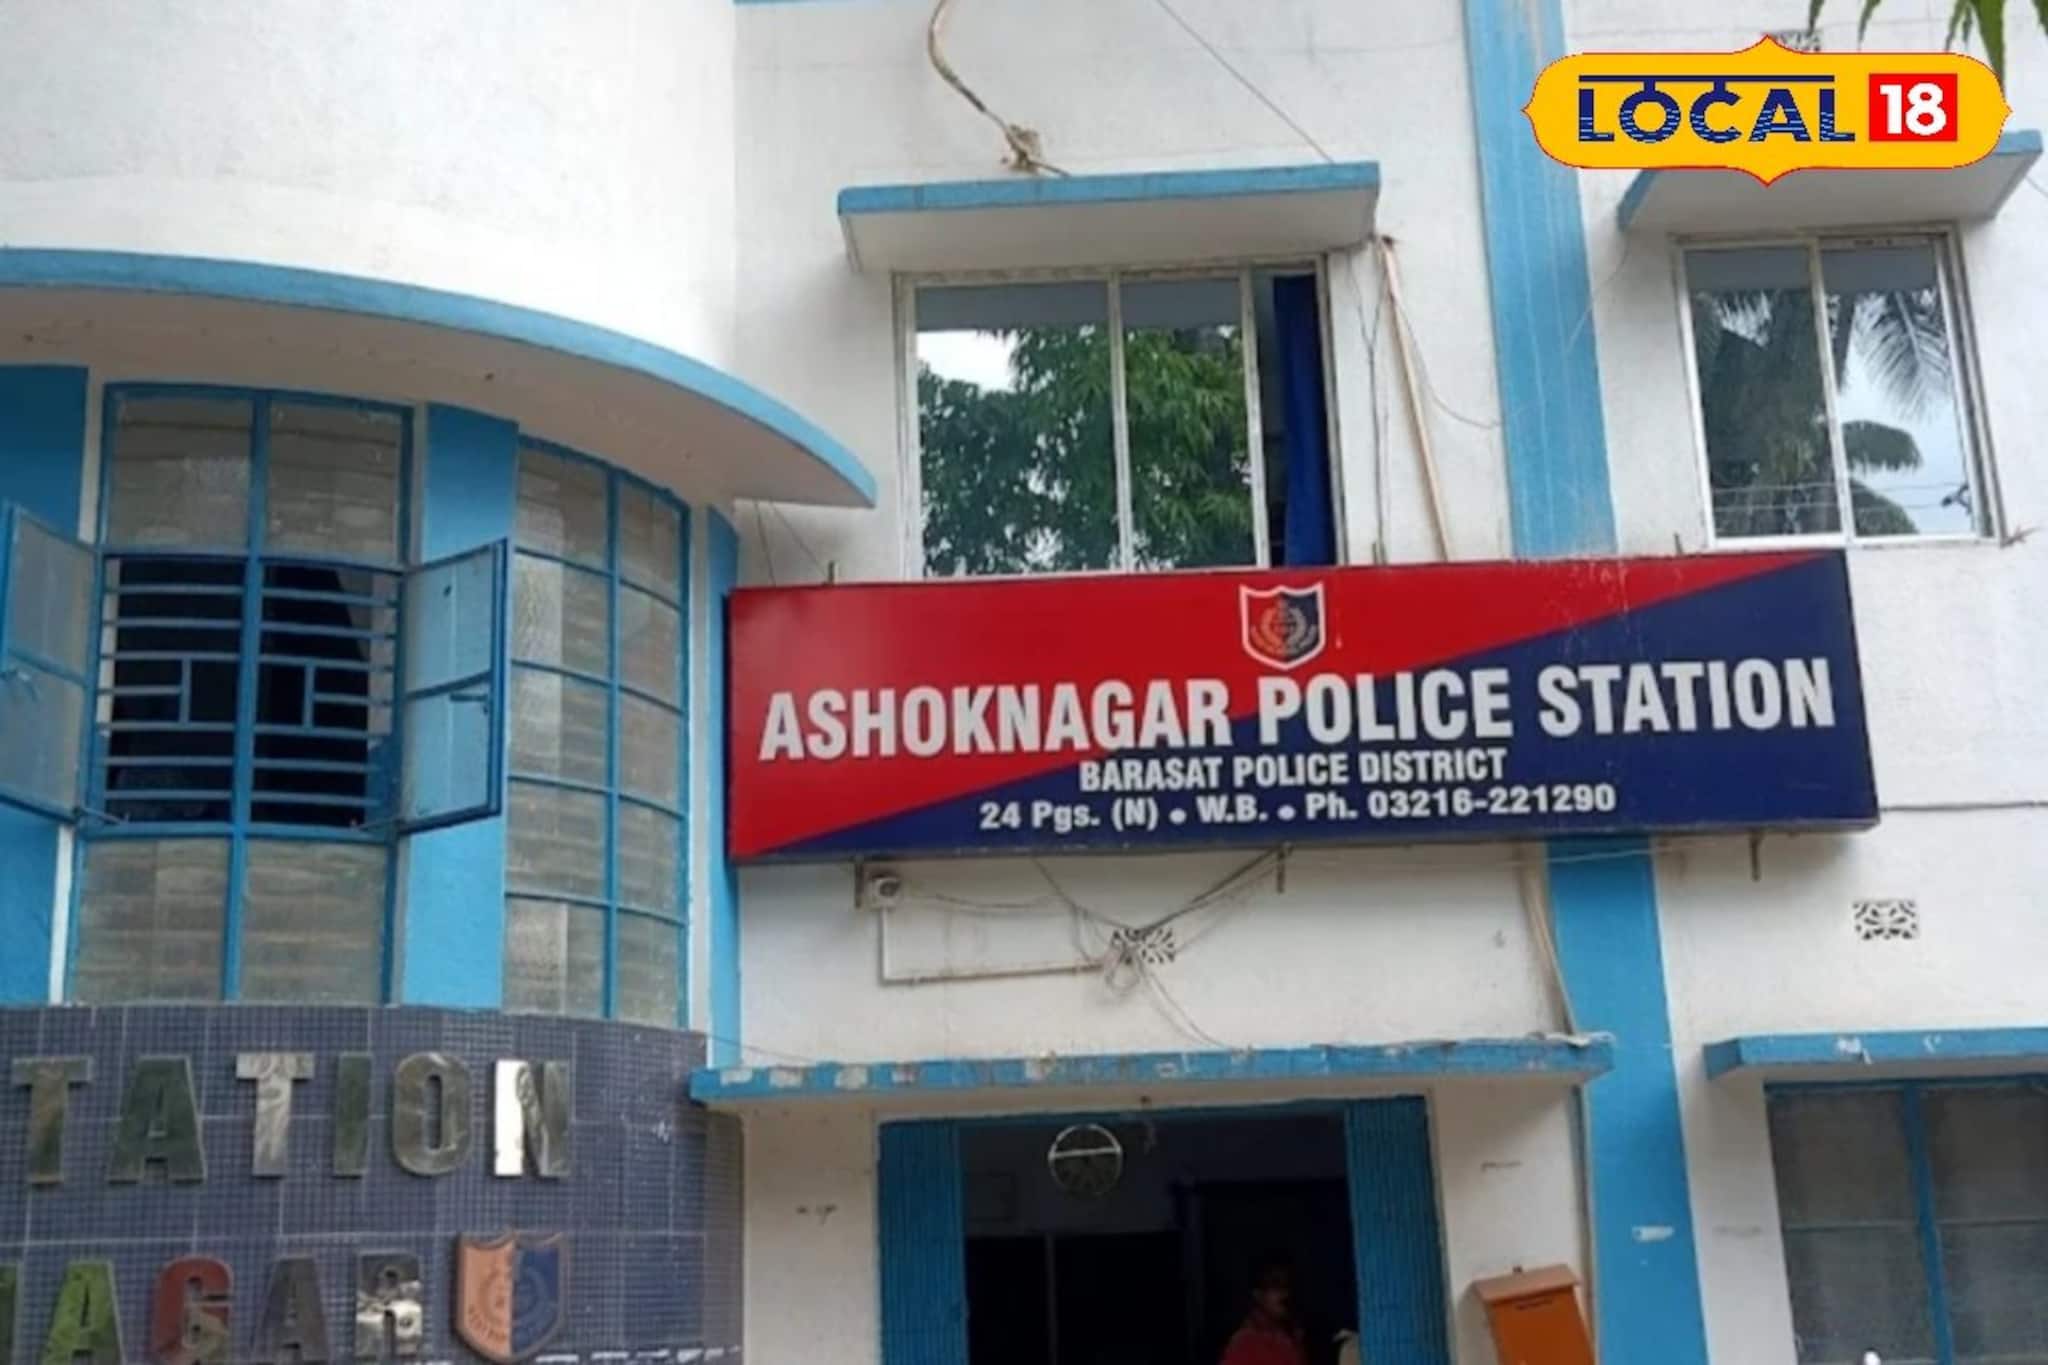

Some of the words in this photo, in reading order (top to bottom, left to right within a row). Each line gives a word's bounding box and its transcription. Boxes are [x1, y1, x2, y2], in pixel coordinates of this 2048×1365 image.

[759, 679, 1231, 761] ASHOKNAGAR
[1258, 668, 1513, 745] POLICE
[1538, 657, 1836, 738] STATION
[1079, 756, 1223, 792] BARASAT
[1234, 752, 1349, 788] POLICE
[1358, 747, 1507, 784] DISTRICT
[979, 801, 1021, 829] 24
[1031, 800, 1100, 833] Pgs.
[1111, 796, 1159, 831] (N)
[1196, 794, 1269, 823] W.B.
[1305, 791, 1358, 820] Ph.
[1367, 783, 1616, 818] 03216-221290
